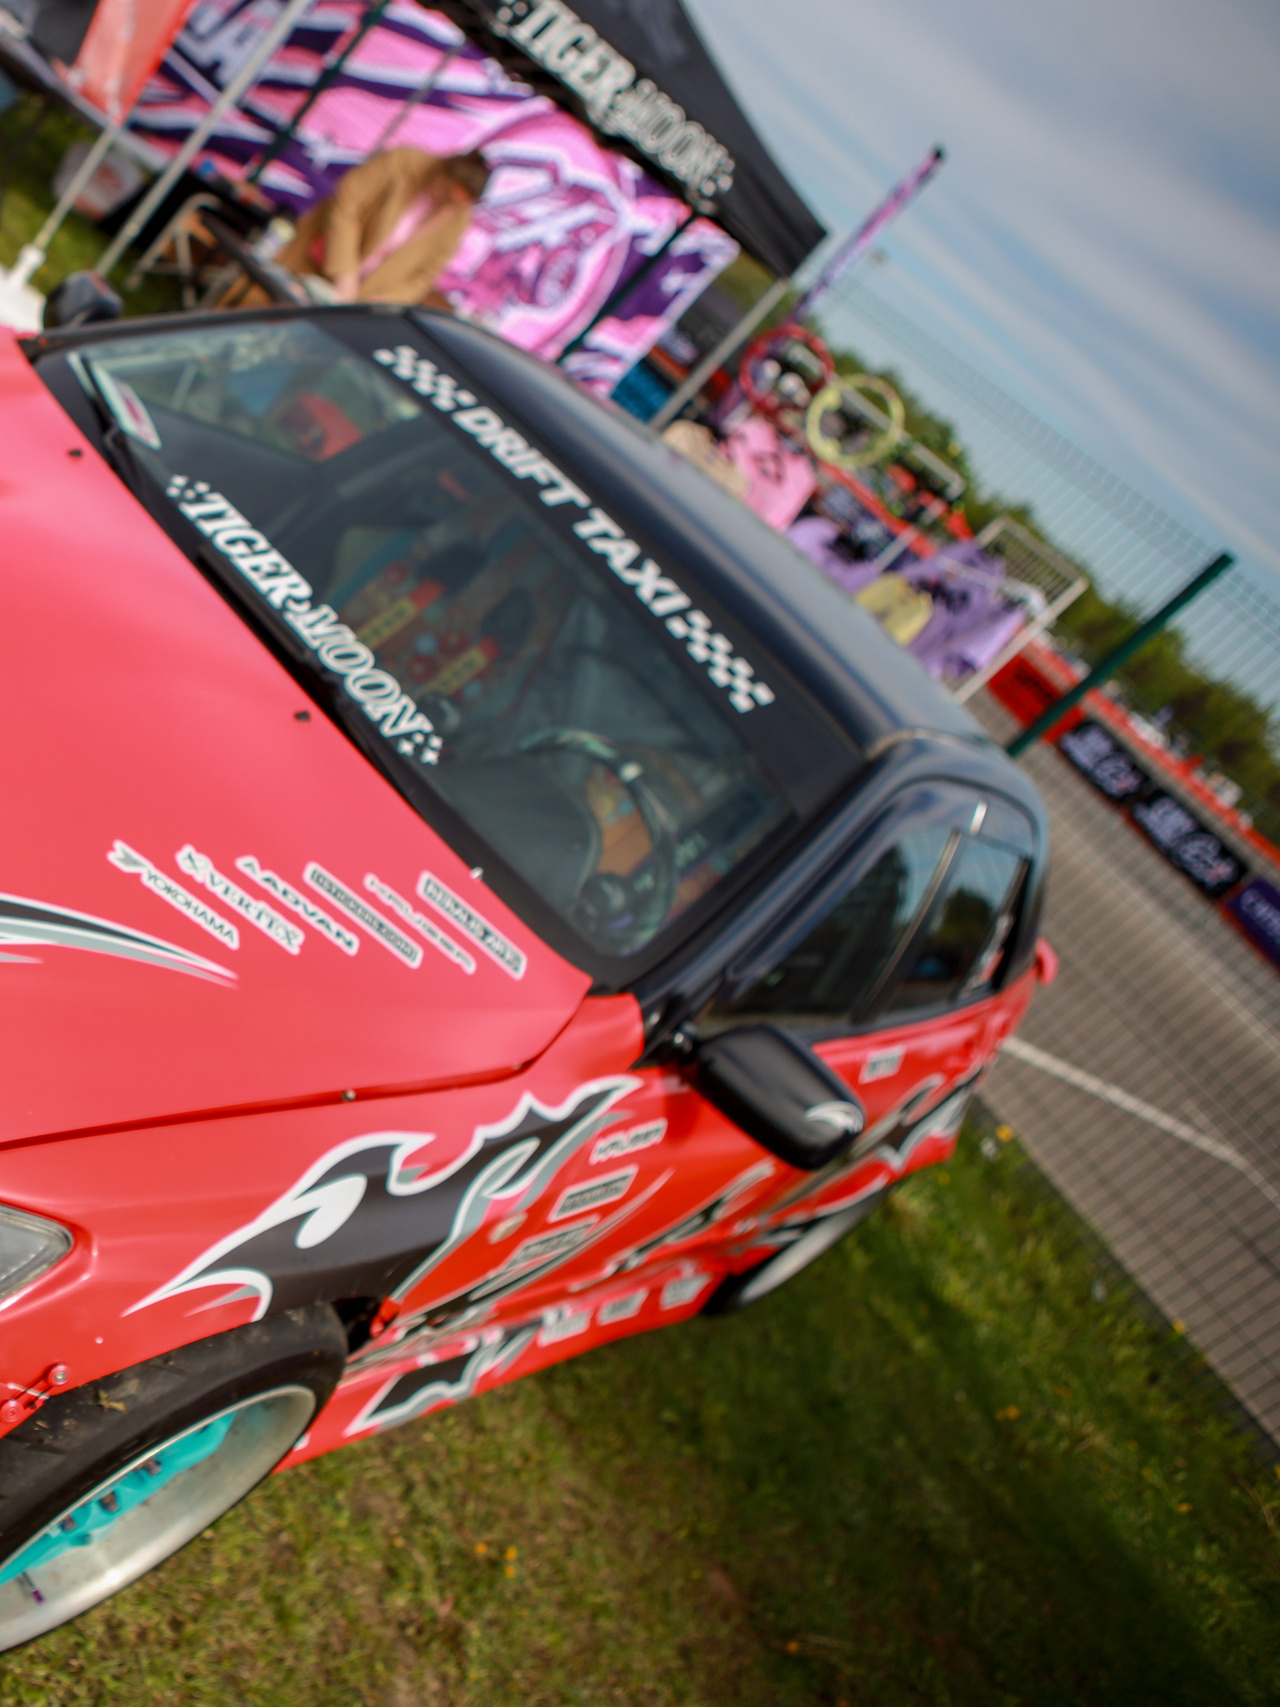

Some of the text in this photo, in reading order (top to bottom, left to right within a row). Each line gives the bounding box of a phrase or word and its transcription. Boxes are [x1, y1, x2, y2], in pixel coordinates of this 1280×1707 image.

[512, 0, 637, 116] TIGER
[452, 406, 691, 617] DRIFT TAXI
[178, 492, 433, 737] TIGER MOON
[144, 868, 237, 945] YOKOHAMA
[207, 869, 304, 948] VERTEX
[258, 870, 355, 950] ADVAN
